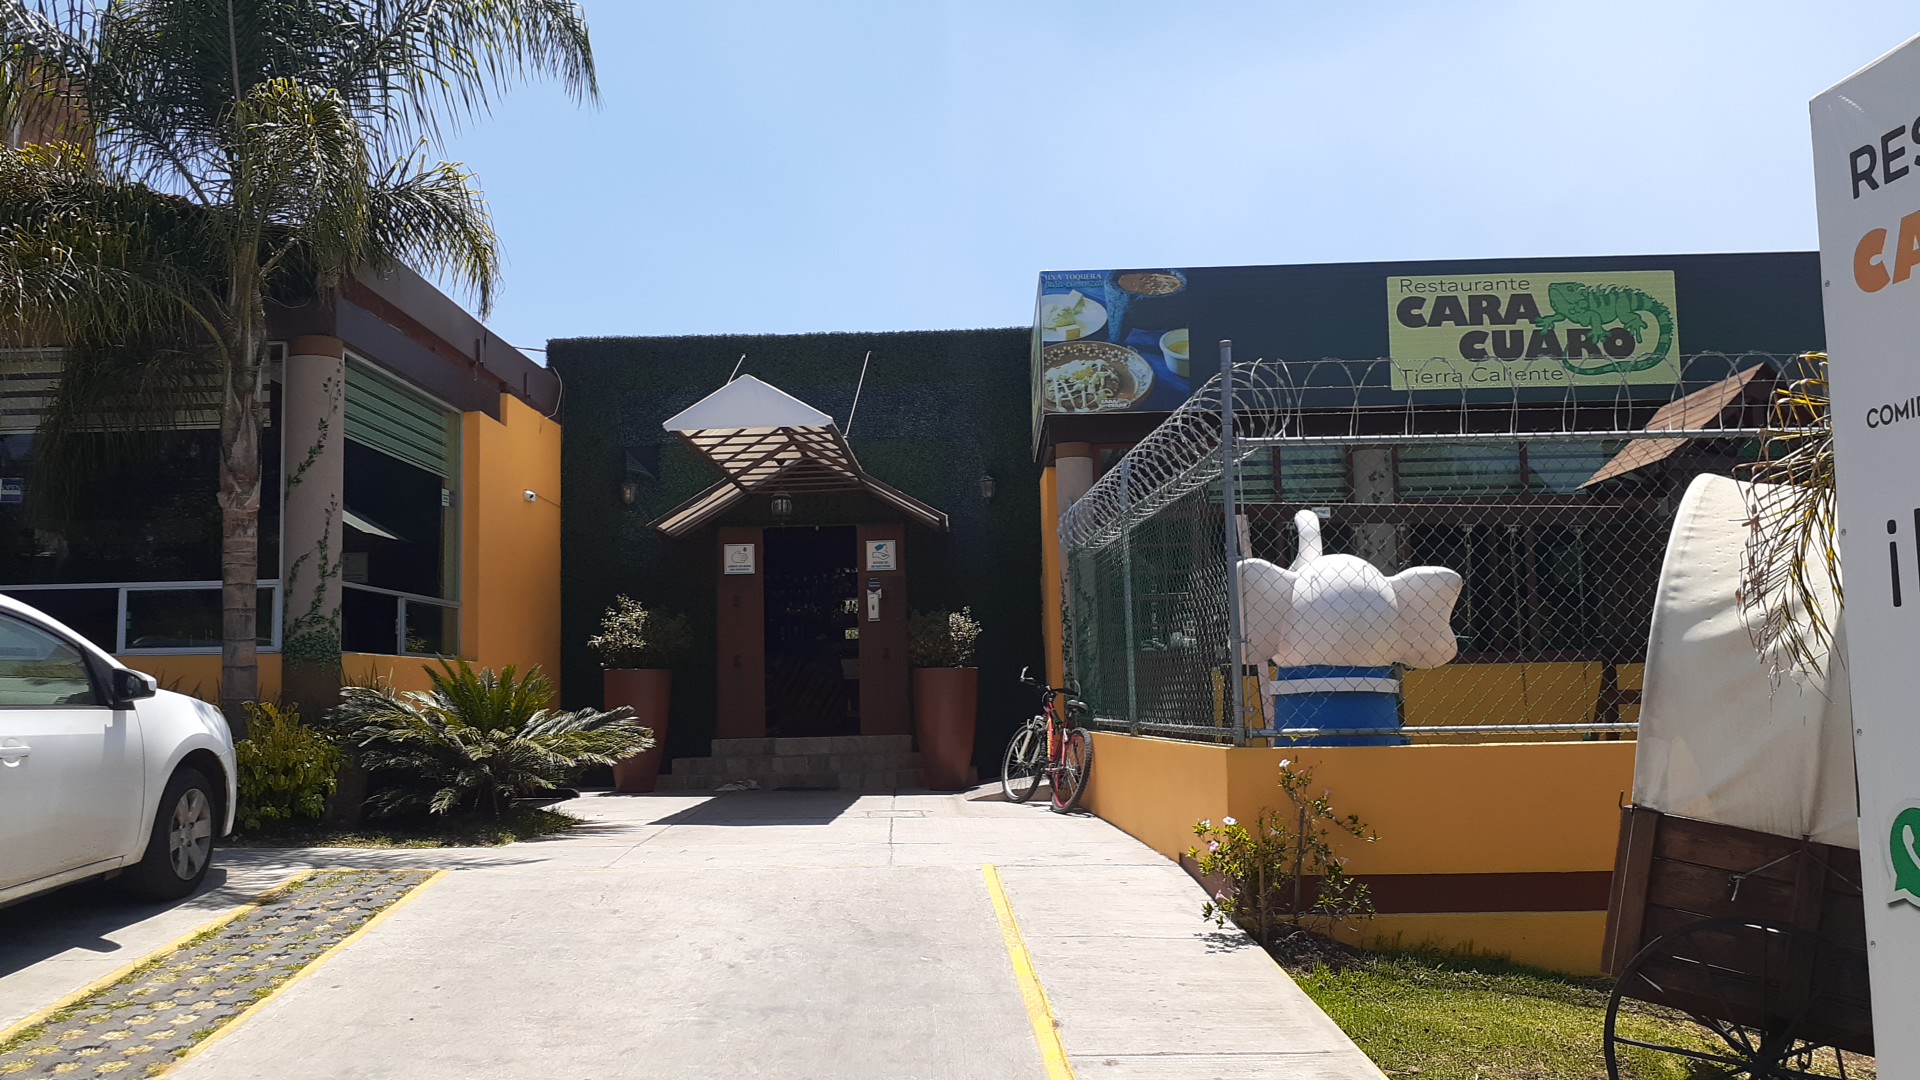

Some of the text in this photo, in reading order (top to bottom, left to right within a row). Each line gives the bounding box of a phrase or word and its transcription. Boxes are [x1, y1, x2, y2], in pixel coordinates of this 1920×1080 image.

[1400, 278, 1530, 293] Restaurante
[1396, 293, 1541, 329] CARA
[1459, 327, 1636, 362] CUARO
[1402, 366, 1563, 384] Tierra Caliente
[1866, 395, 1920, 429] COMI
